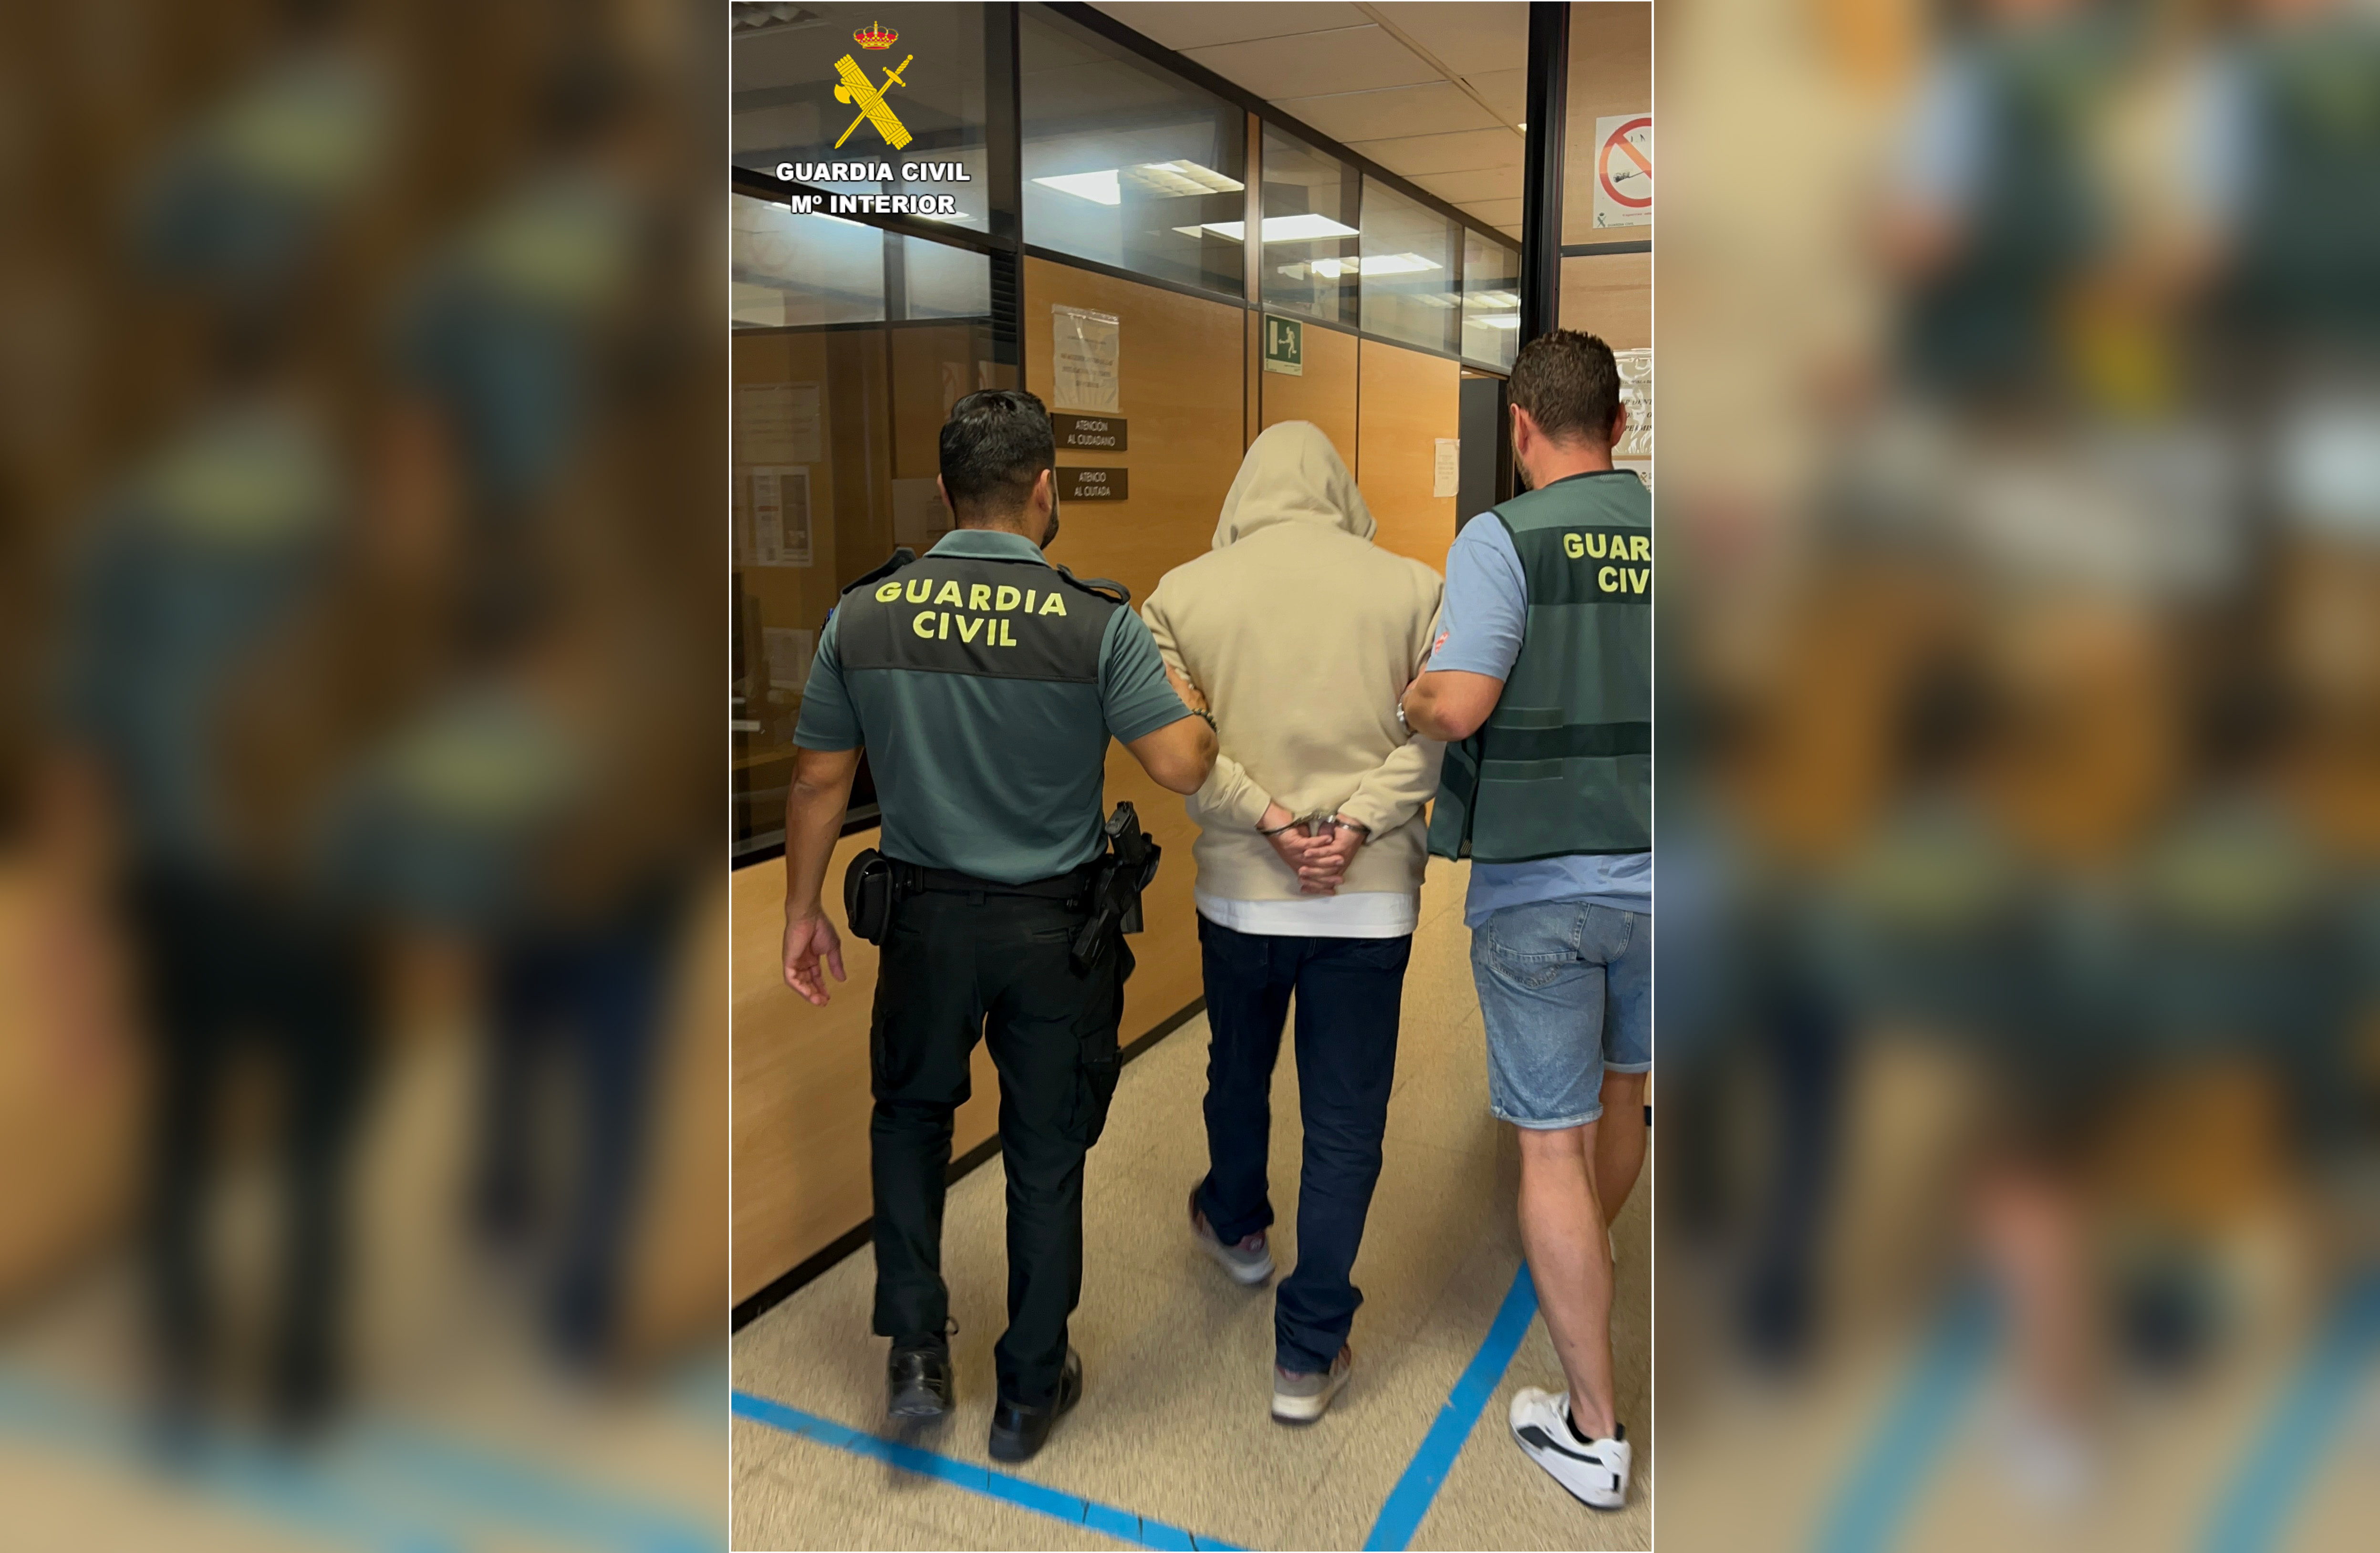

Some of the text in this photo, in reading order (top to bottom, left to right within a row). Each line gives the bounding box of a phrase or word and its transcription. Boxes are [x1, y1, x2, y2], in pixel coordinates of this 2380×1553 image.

[1075, 419, 1108, 432] ATENCIÓN
[1067, 434, 1115, 446] AL CIUDADANO
[1074, 486, 1083, 497] AL
[875, 579, 1067, 616] GUARDIA
[913, 611, 1017, 647] CIVIL
